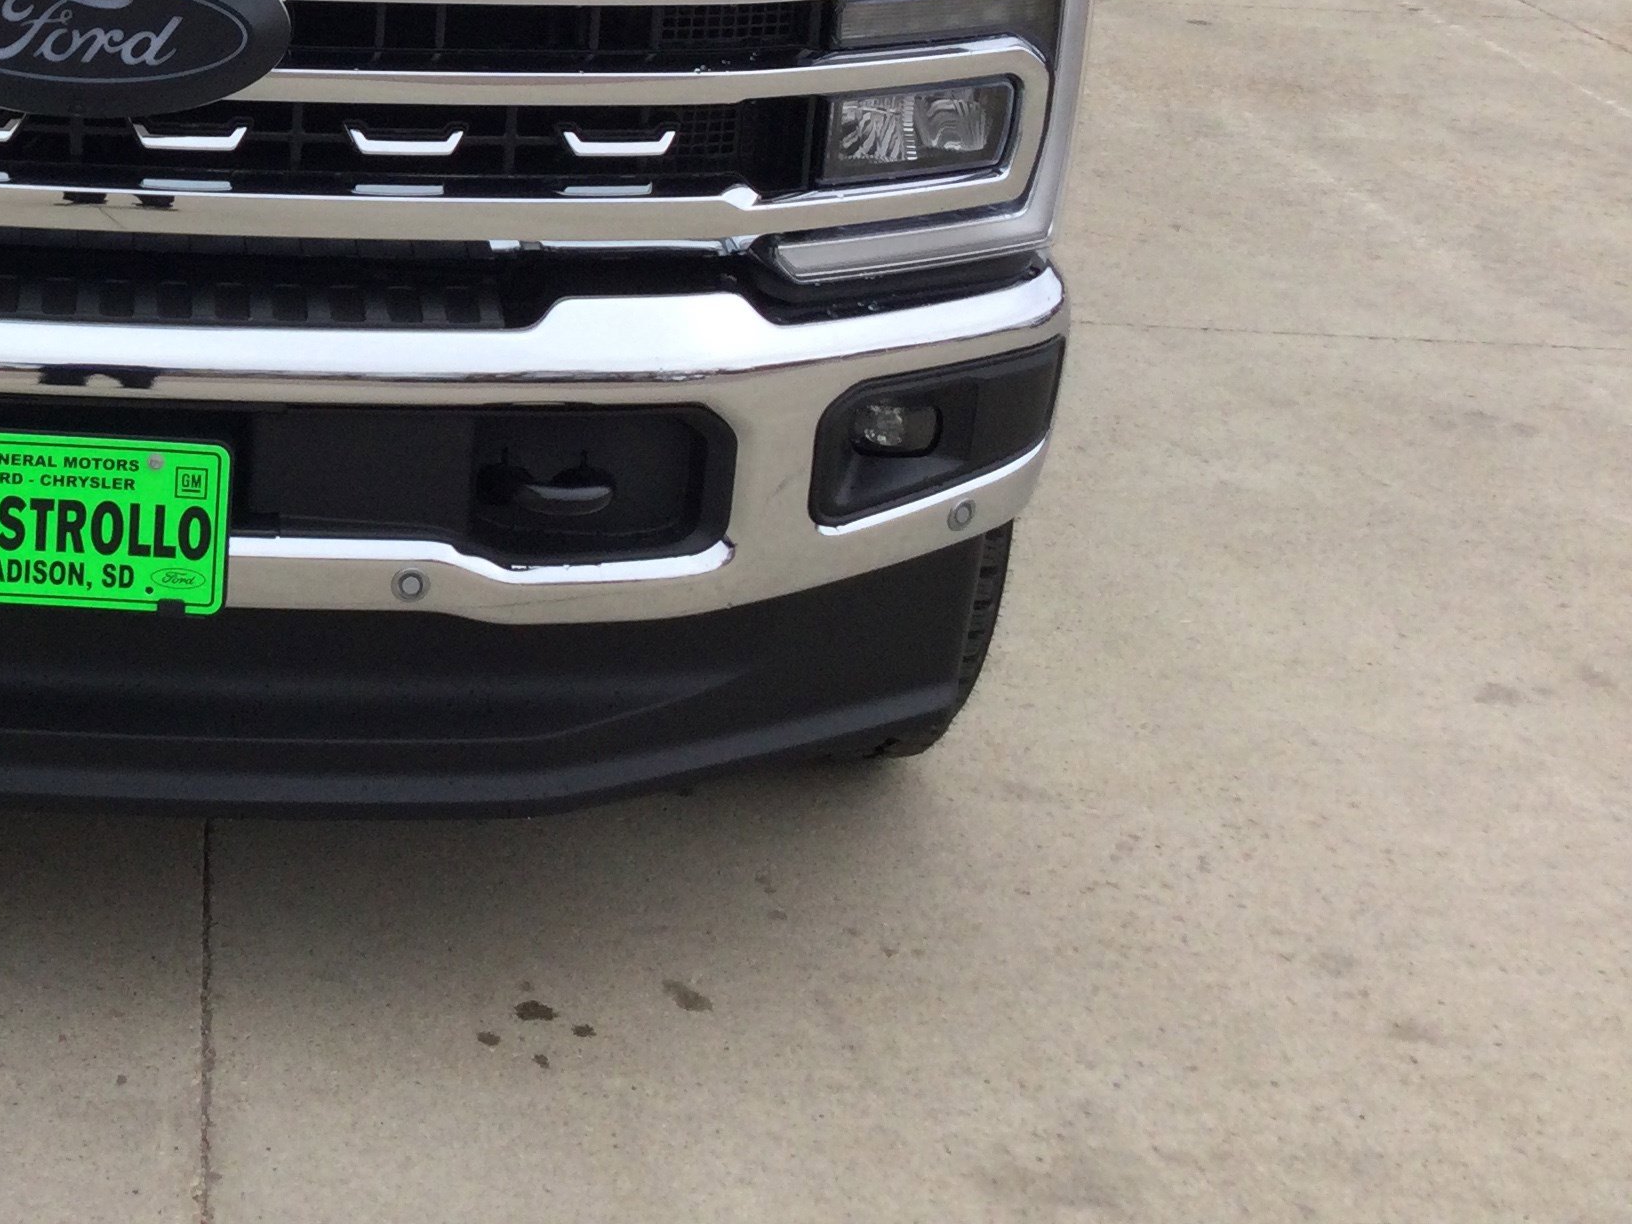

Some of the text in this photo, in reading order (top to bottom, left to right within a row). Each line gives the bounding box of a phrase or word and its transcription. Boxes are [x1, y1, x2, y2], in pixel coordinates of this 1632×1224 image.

[63, 456, 140, 472] MOTORS
[40, 474, 136, 491] CHRYSLER
[181, 473, 202, 489] GM
[101, 564, 135, 589] SD
[161, 572, 196, 586] Ford
